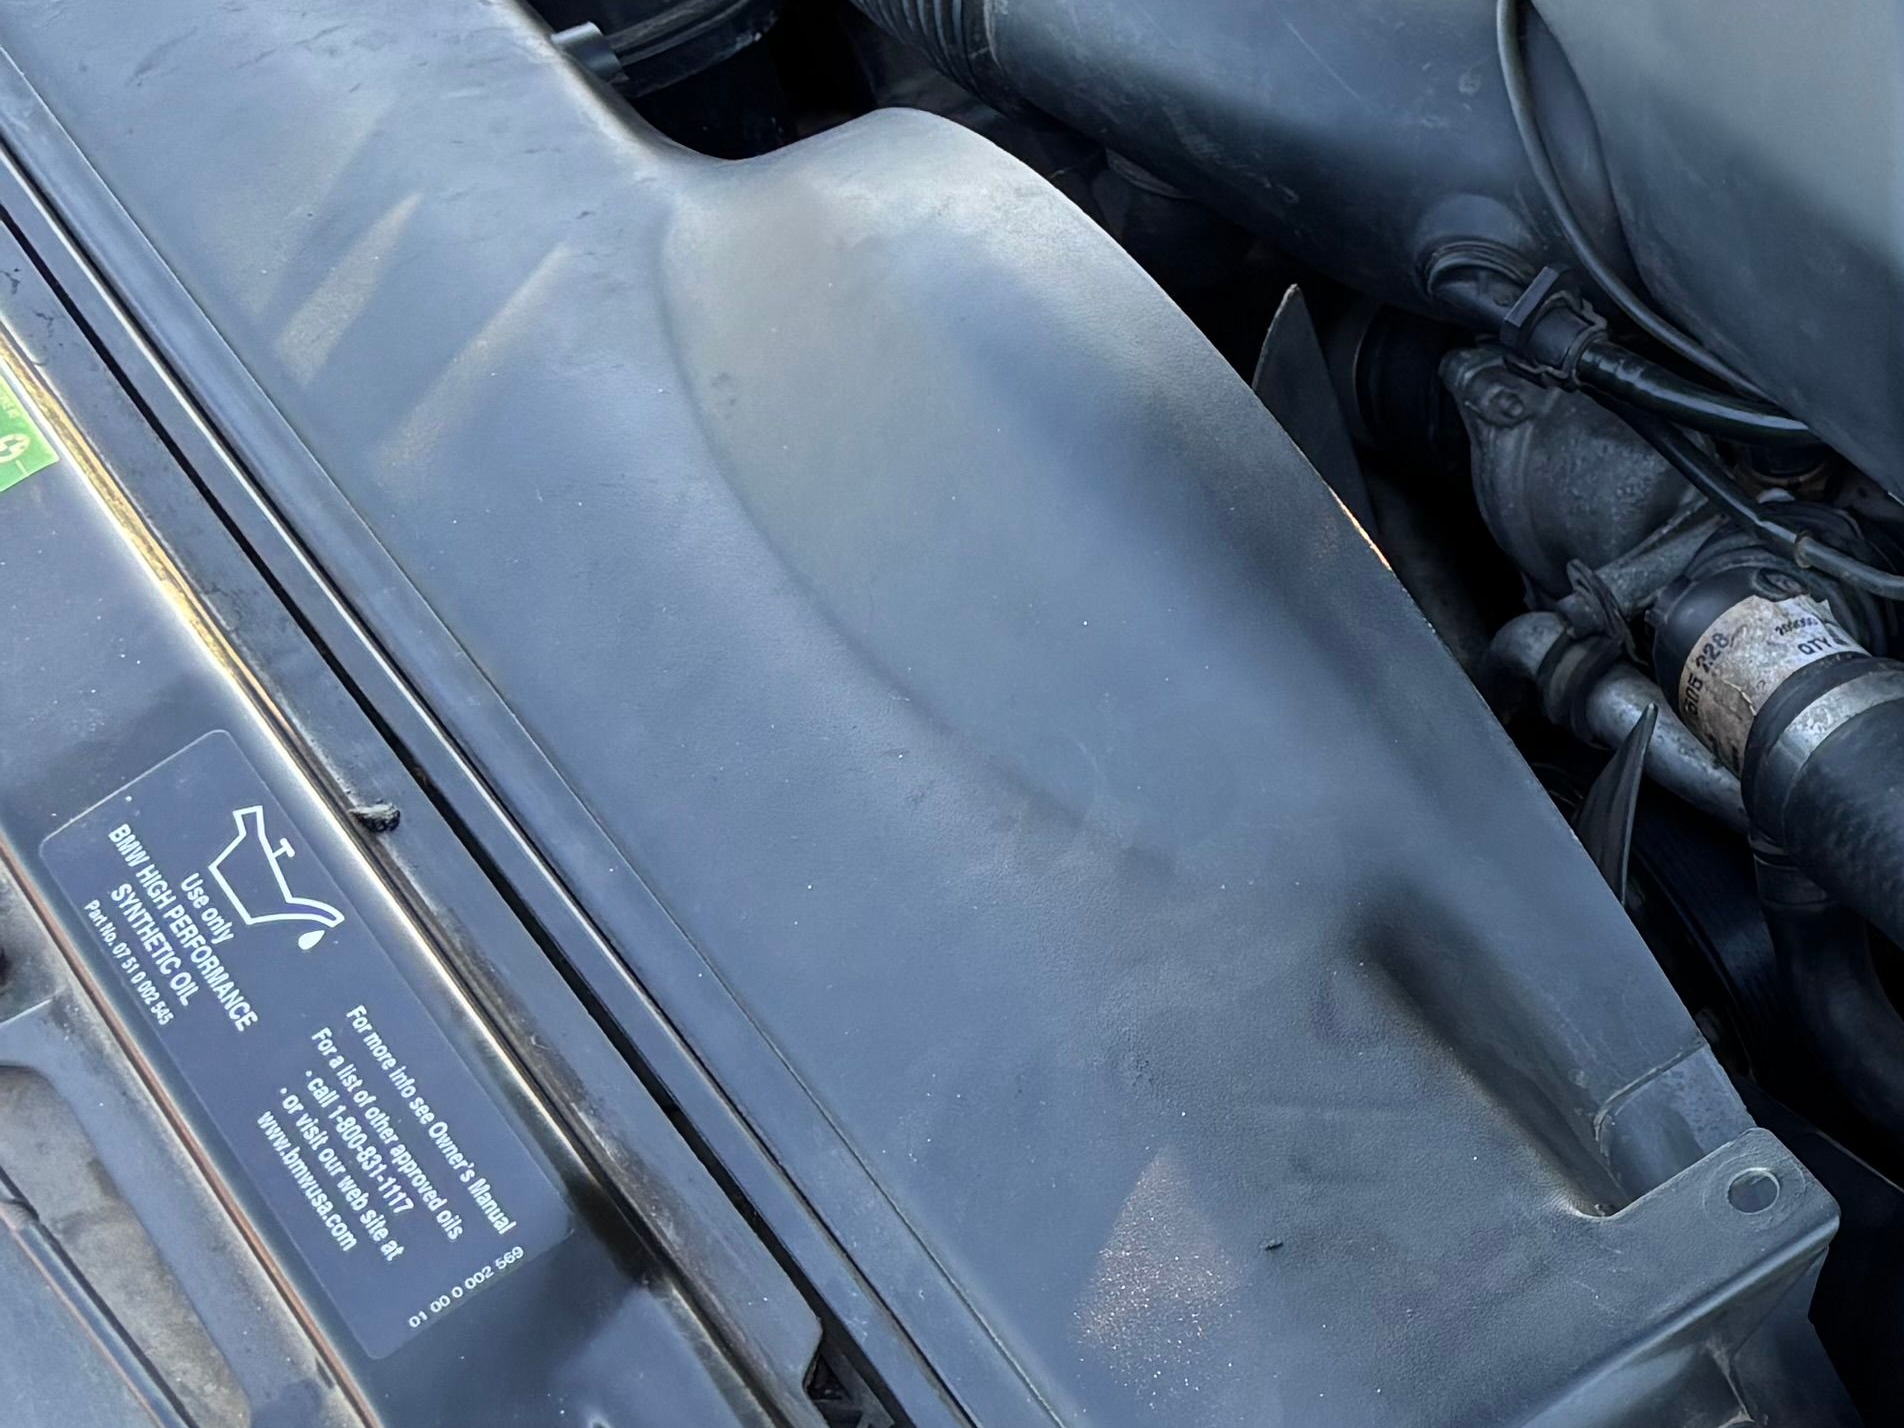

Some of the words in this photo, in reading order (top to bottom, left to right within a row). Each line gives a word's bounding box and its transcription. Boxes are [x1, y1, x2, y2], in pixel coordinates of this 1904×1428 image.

[1797, 637, 1832, 656] QTY
[177, 871, 215, 910] Use
[82, 898, 109, 927] Part
[107, 822, 150, 869] BMW
[135, 863, 177, 909] HIGH
[161, 903, 260, 1033] PERFORMANCE
[194, 902, 239, 948] only
[97, 921, 122, 947] No.
[108, 881, 183, 977] SYNTHETIC
[167, 969, 204, 1007] OIL
[110, 941, 131, 960] 07
[120, 955, 140, 974] 51
[129, 970, 147, 984] 0
[135, 979, 160, 1005] 002
[149, 1000, 175, 1026] 545
[310, 1026, 341, 1058] For
[328, 1053, 346, 1069] a
[336, 1063, 365, 1092] list
[352, 1085, 377, 1109] of
[344, 1003, 377, 1037] For
[363, 1030, 398, 1071] more
[388, 1064, 422, 1100] info
[408, 1095, 436, 1125] see
[466, 1176, 517, 1236] Manual
[363, 1102, 402, 1147] other
[306, 1073, 340, 1109] call
[326, 1102, 415, 1218] 1-800-831-1117
[255, 1108, 360, 1252] www.bmwusa.com
[280, 1093, 305, 1116] or
[293, 1109, 331, 1151] visit
[316, 1145, 346, 1178] our
[335, 1171, 372, 1212] web
[358, 1205, 394, 1243] site
[379, 1236, 406, 1262] at
[385, 1139, 448, 1214] approved
[434, 1206, 468, 1241] oils
[407, 1310, 428, 1329] 01
[428, 1293, 452, 1314] 00
[449, 1284, 465, 1300] 0
[462, 1264, 495, 1292] 002
[492, 1244, 525, 1271] 569
